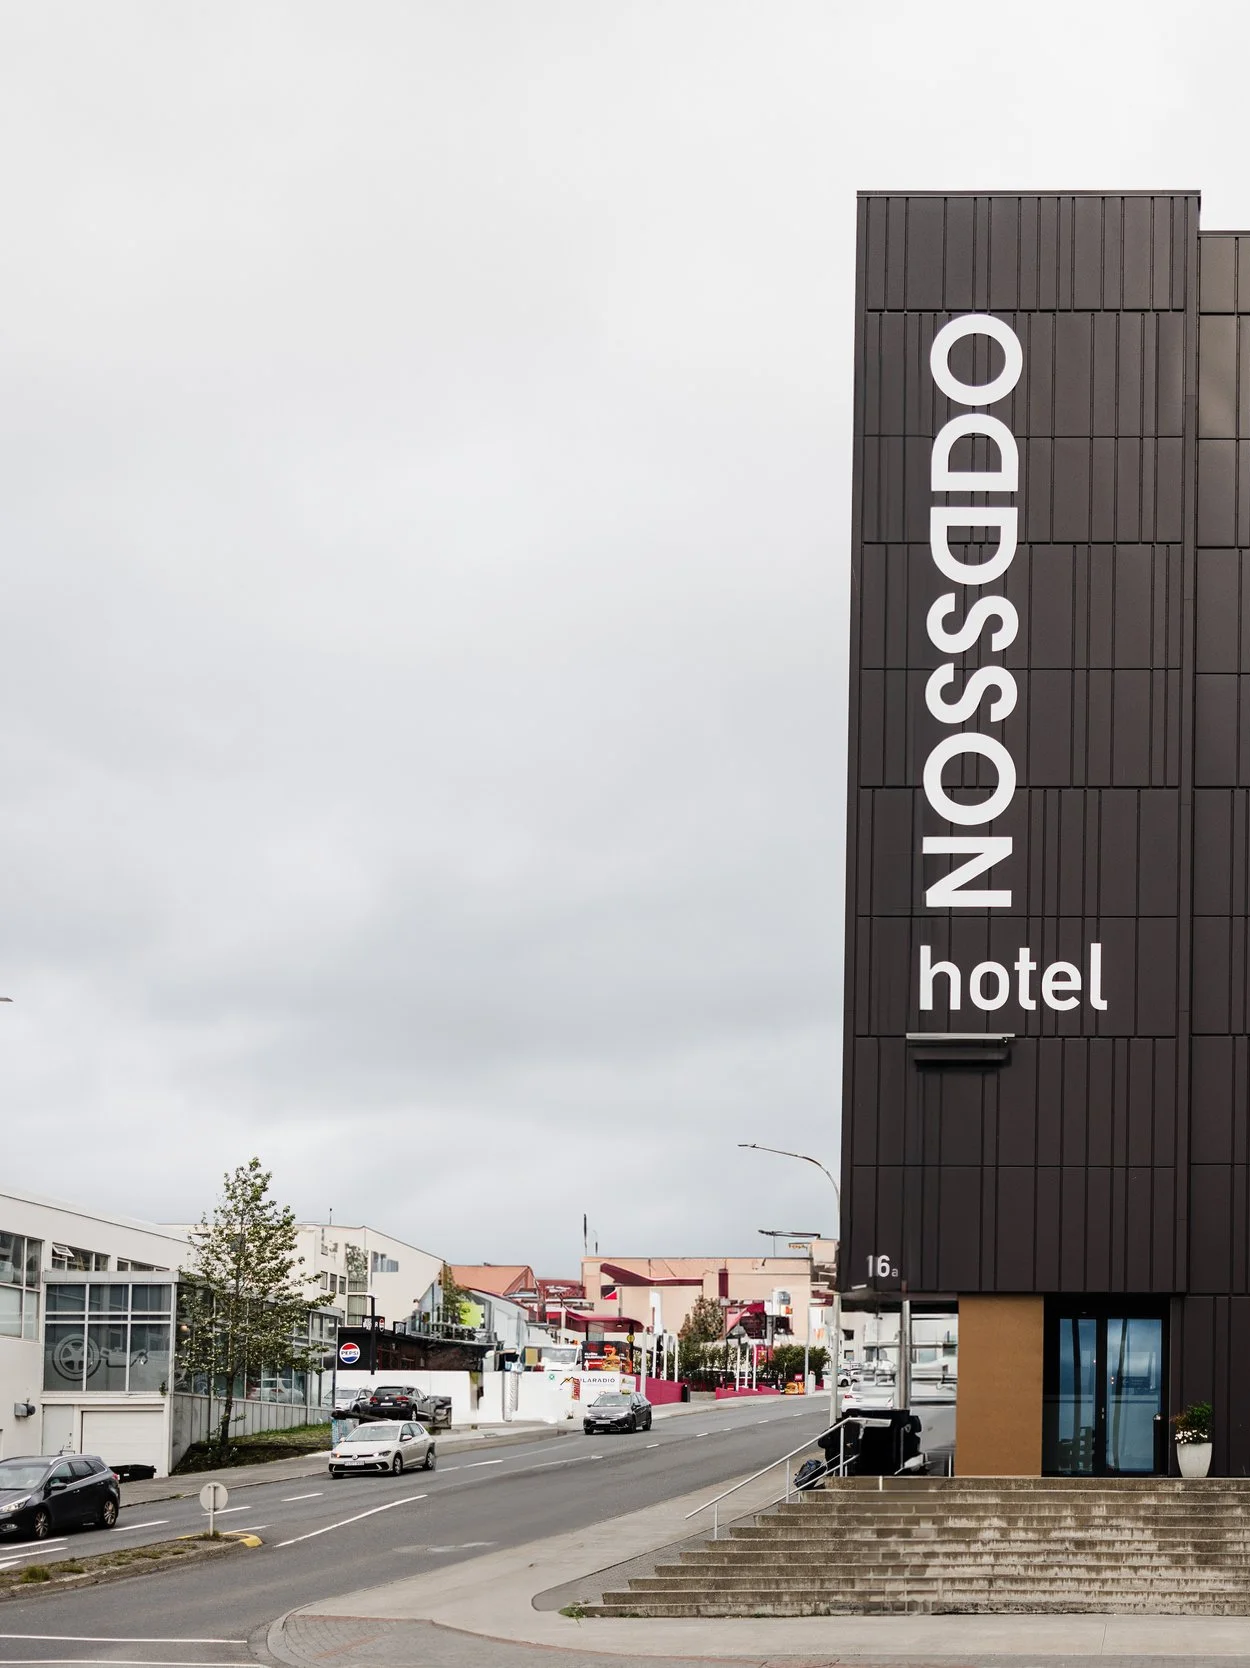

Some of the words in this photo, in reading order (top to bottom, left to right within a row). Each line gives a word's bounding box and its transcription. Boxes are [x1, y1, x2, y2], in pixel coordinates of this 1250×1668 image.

[922, 313, 1023, 908] ODDSSON
[919, 943, 1108, 1011] hotel
[866, 1254, 899, 1278] 16a
